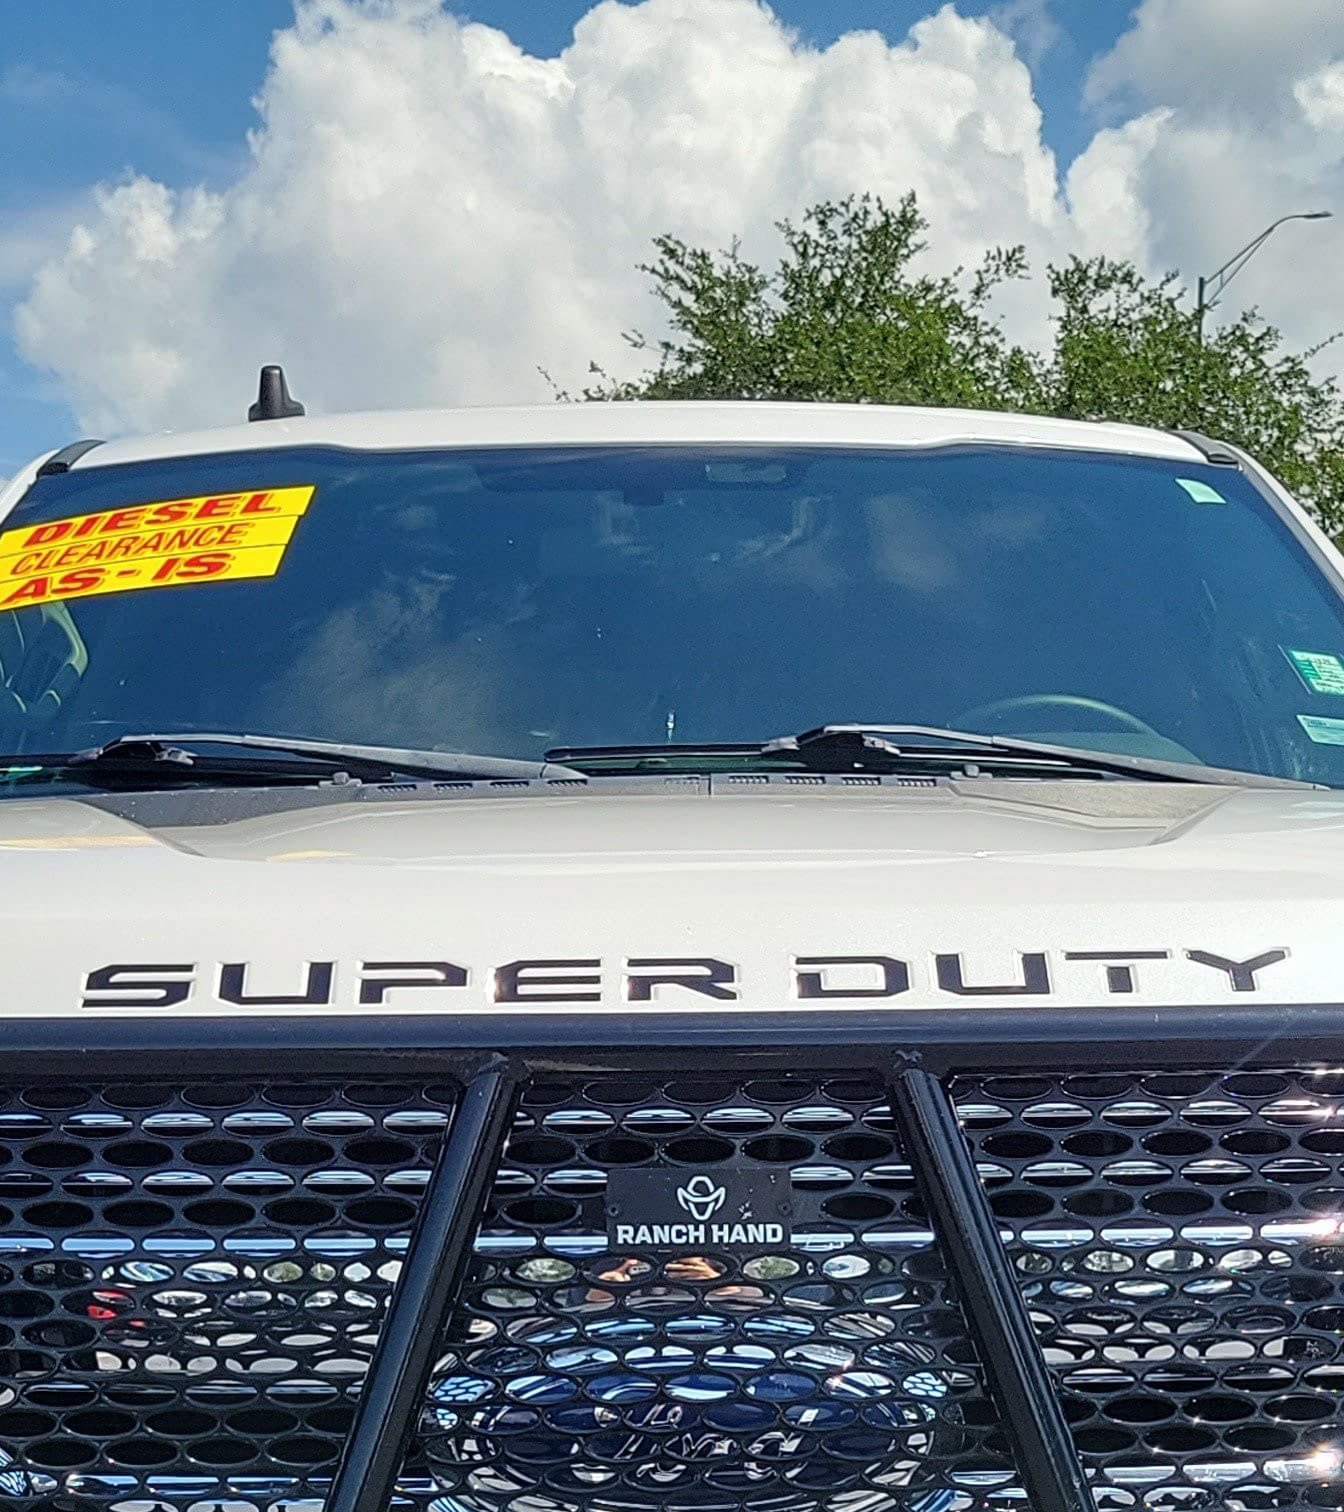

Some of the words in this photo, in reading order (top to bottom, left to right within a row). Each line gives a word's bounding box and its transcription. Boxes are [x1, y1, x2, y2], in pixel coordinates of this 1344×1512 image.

[22, 493, 279, 549] DIESEL
[11, 523, 255, 576] CLEARANCE
[81, 957, 740, 1009] SUPER
[790, 947, 1293, 1000] DUTY
[616, 1223, 706, 1245] RANCH
[711, 1222, 784, 1243] HAND
